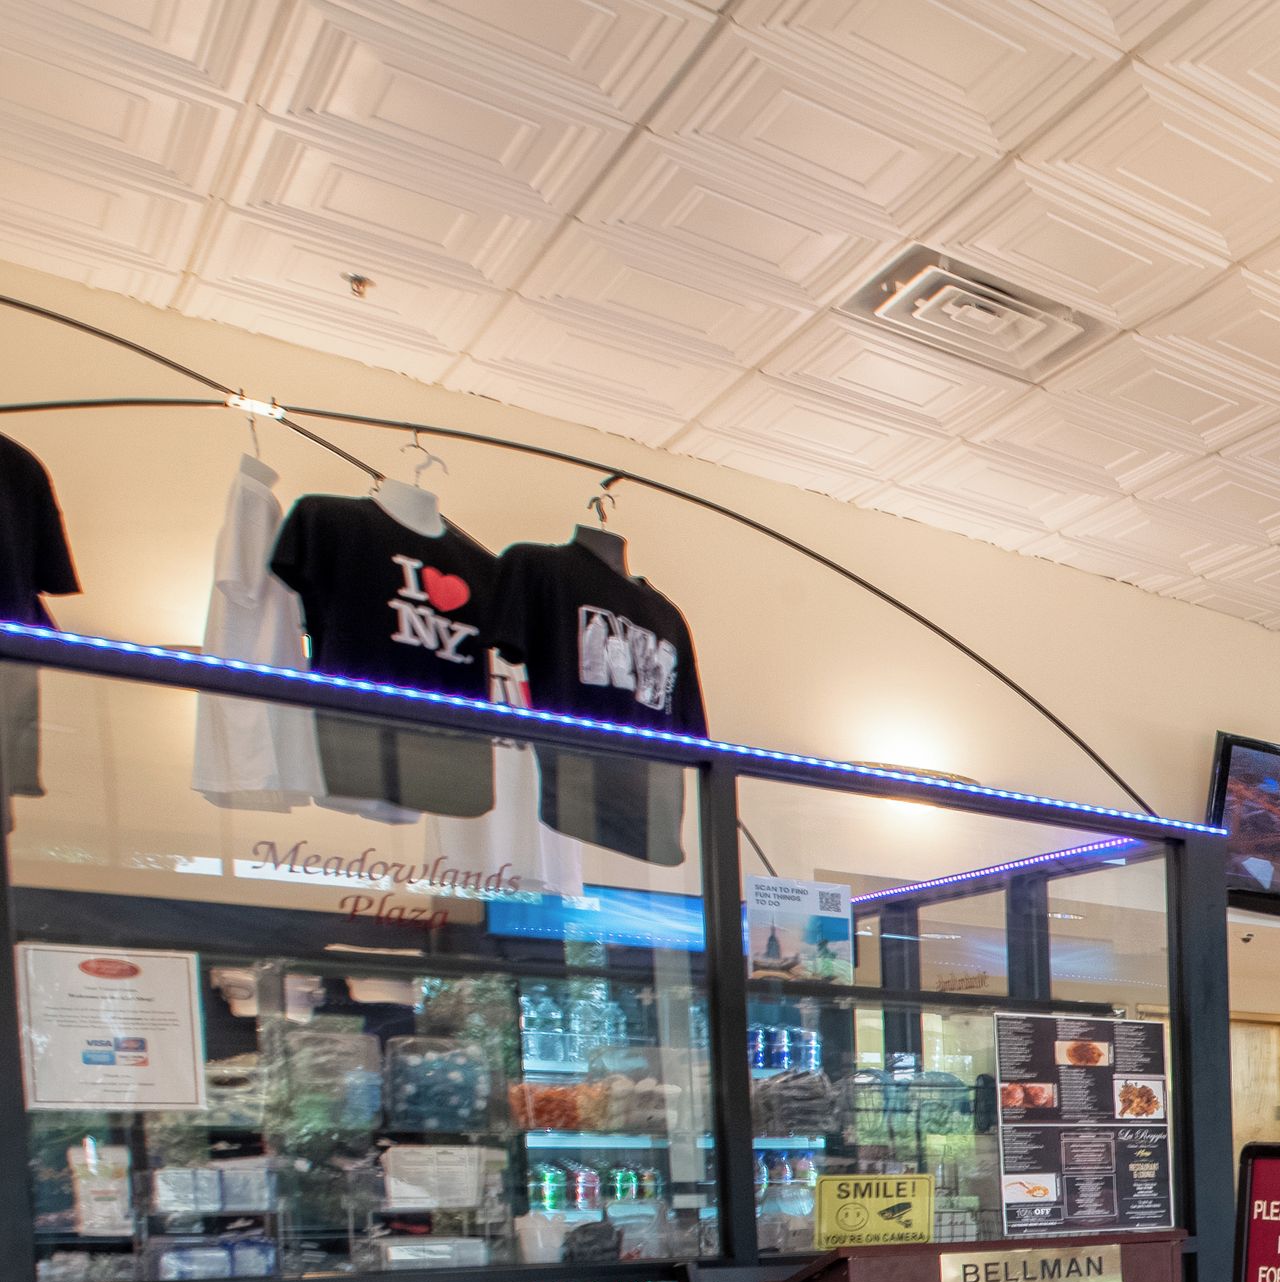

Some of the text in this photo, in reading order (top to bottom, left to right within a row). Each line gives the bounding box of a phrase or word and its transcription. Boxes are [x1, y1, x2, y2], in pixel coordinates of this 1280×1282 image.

[391, 554, 429, 601] I
[252, 840, 522, 896] Meadowlands
[755, 884, 777, 893] SCAN
[773, 893, 801, 902] THINGS
[339, 893, 450, 927] Plaza
[86, 1039, 113, 1047] VISA
[837, 1181, 916, 1200] SMILE!
[824, 1232, 926, 1245] YOU'RE ON CAMERA
